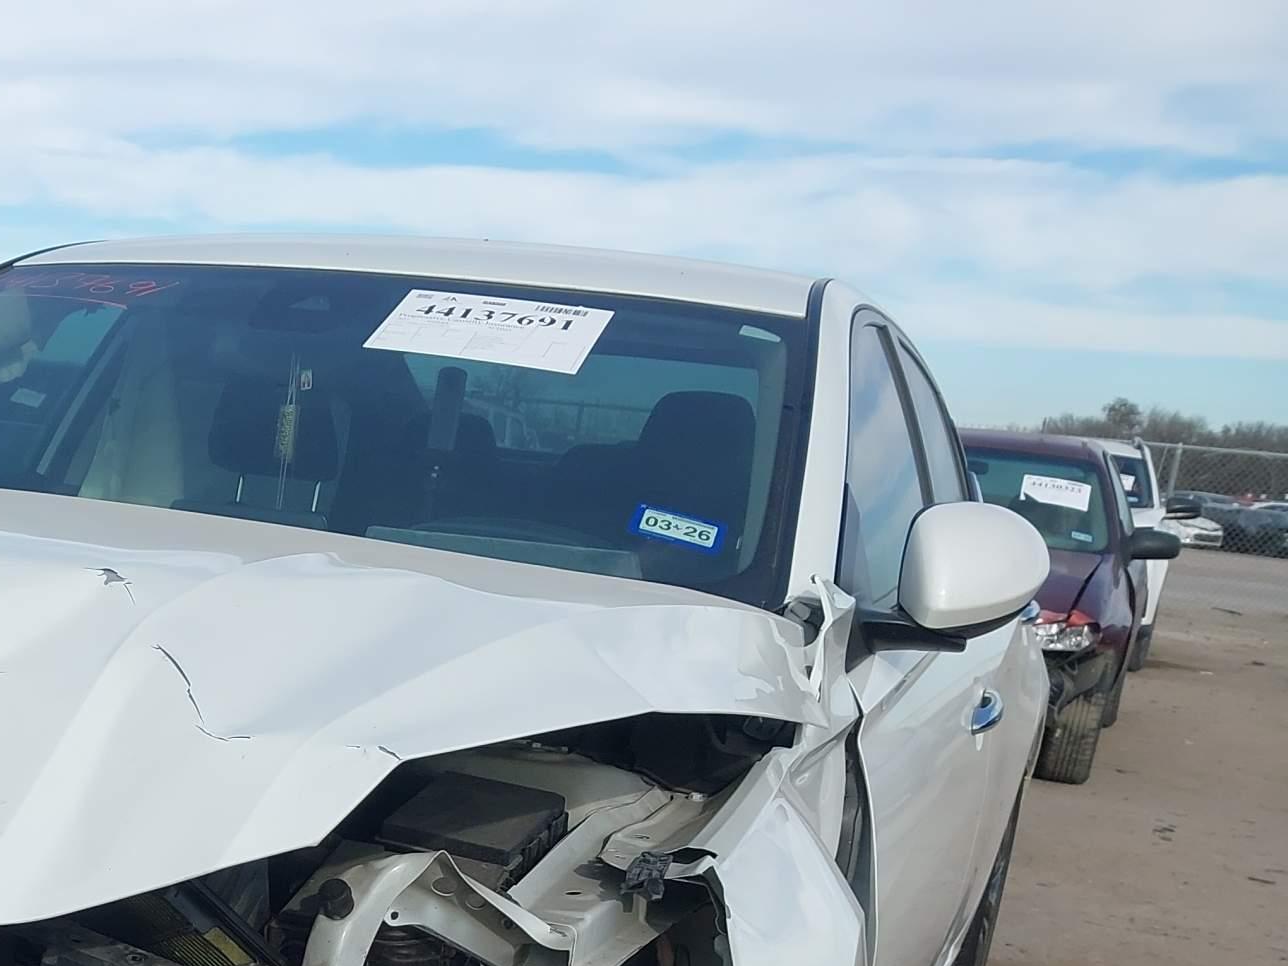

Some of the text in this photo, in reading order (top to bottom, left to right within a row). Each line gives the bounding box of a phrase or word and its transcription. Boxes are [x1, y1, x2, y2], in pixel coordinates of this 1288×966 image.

[415, 303, 575, 331] 44137691
[645, 515, 673, 531] 03
[683, 525, 712, 542] 26
